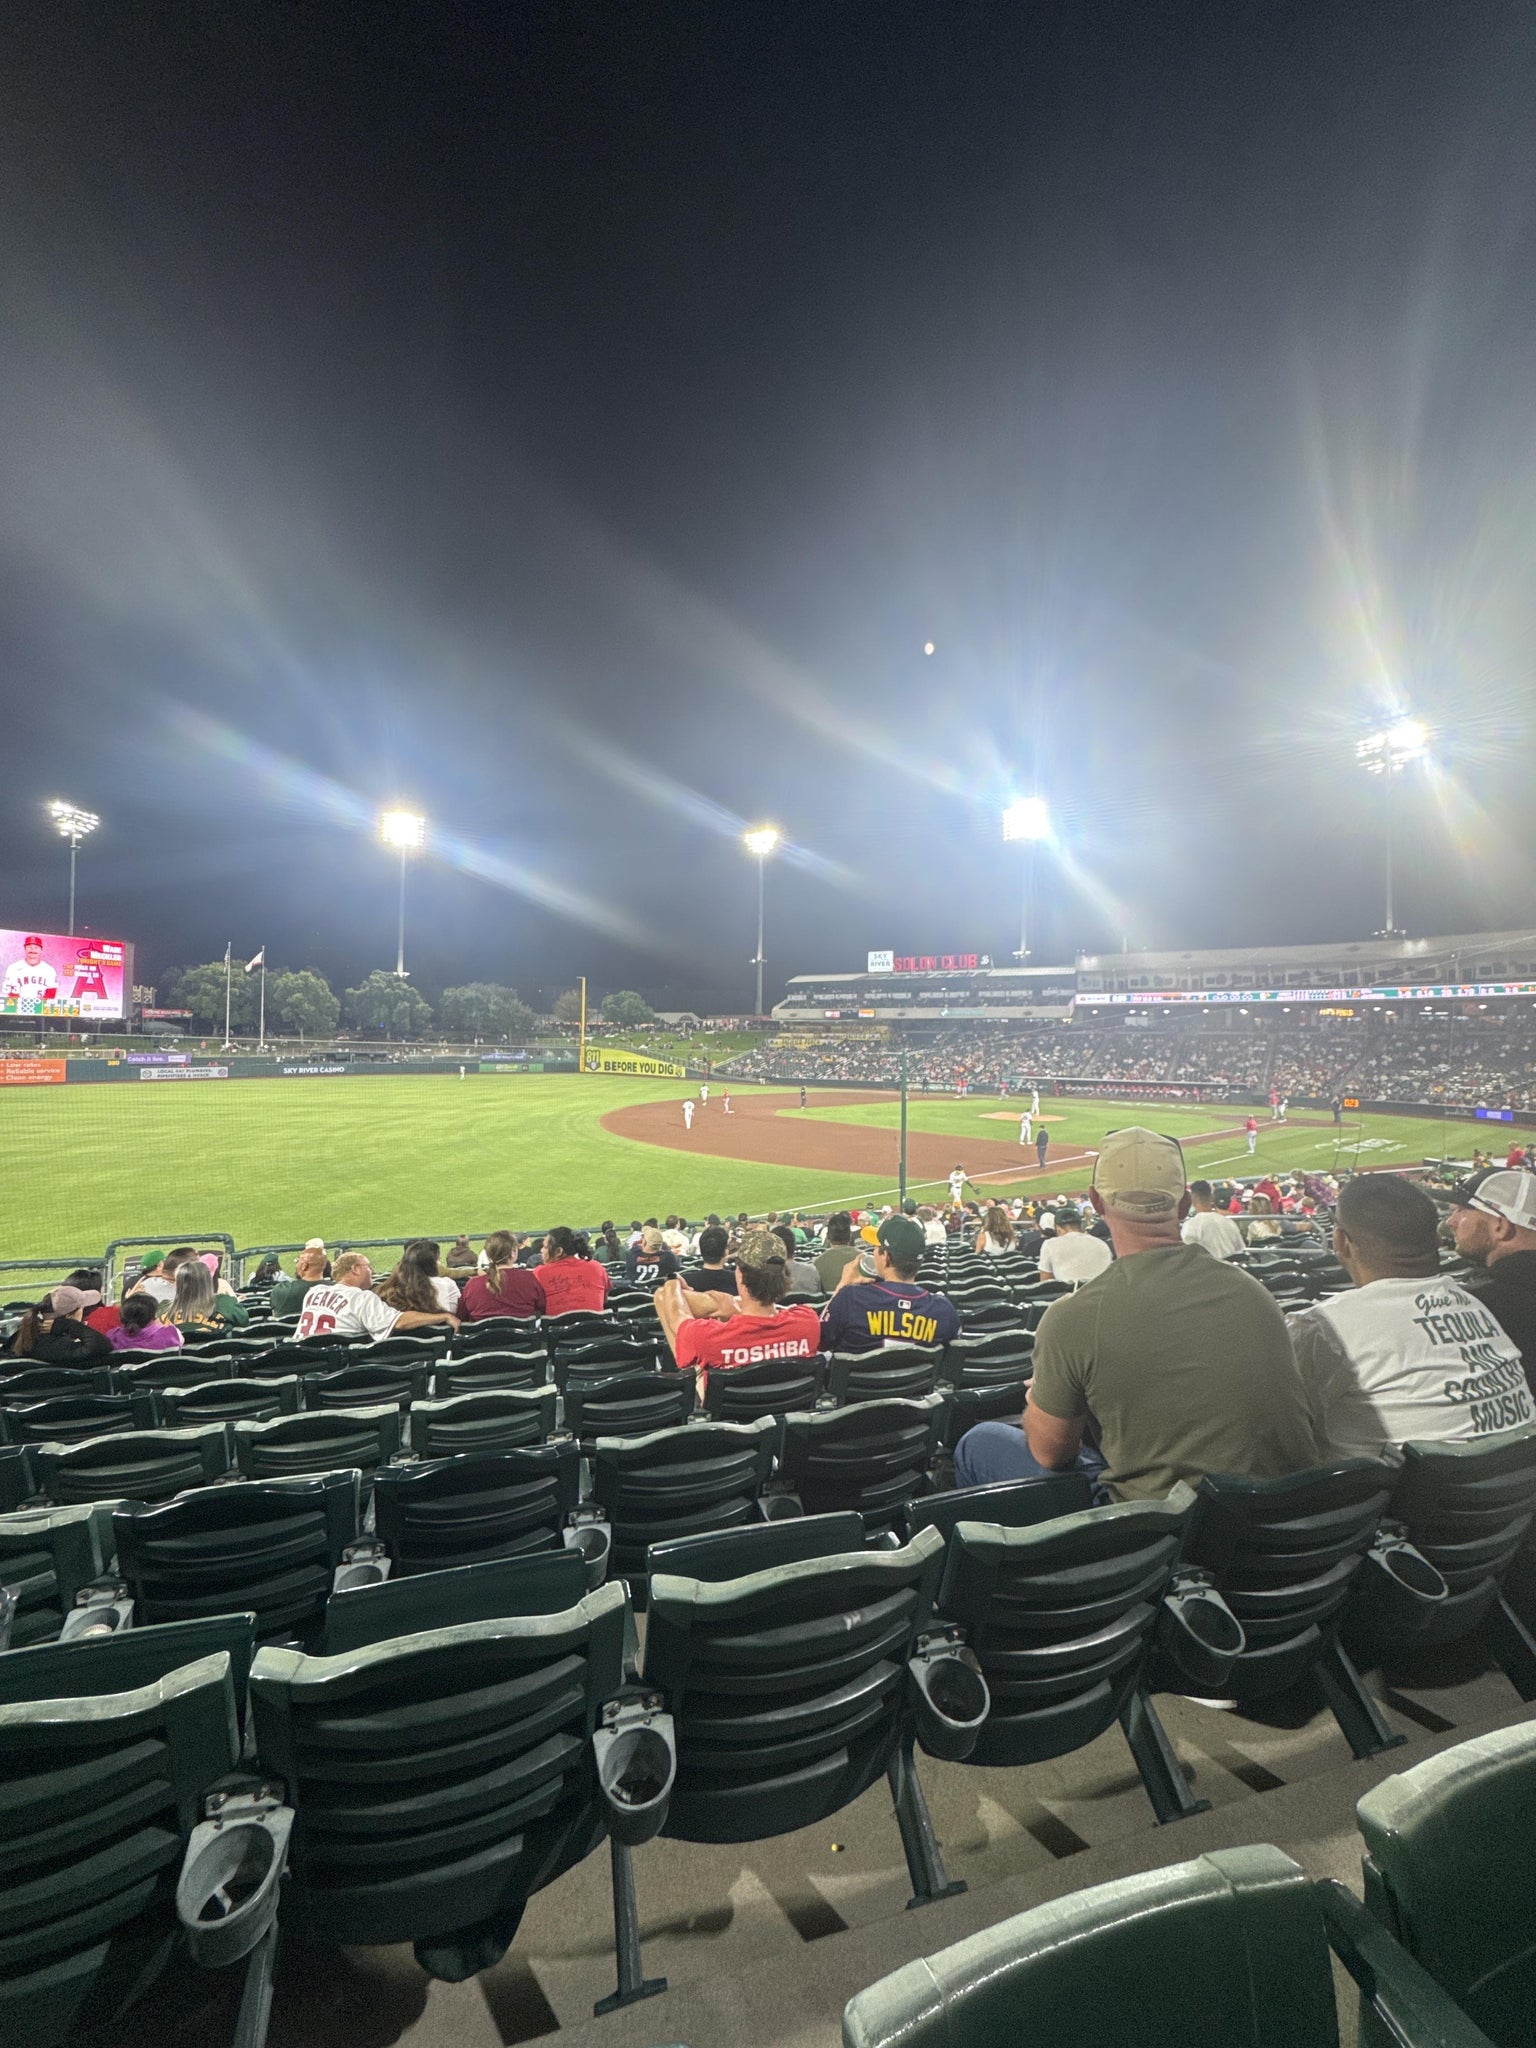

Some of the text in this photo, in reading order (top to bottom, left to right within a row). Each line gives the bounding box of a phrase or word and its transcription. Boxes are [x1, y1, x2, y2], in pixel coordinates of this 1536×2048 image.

[894, 953, 978, 972] SOLON CLUB
[586, 1050, 600, 1063] 811
[604, 1062, 674, 1075] BEFORE YOU DIG
[636, 1264, 659, 1280] 22
[1415, 1294, 1452, 1316] Give
[867, 1310, 938, 1342] WILSON
[1412, 1310, 1500, 1346] TEQUILA
[721, 1338, 810, 1364] TOSHIBA
[1460, 1344, 1508, 1373] AND
[1470, 1390, 1530, 1432] MUSIC
